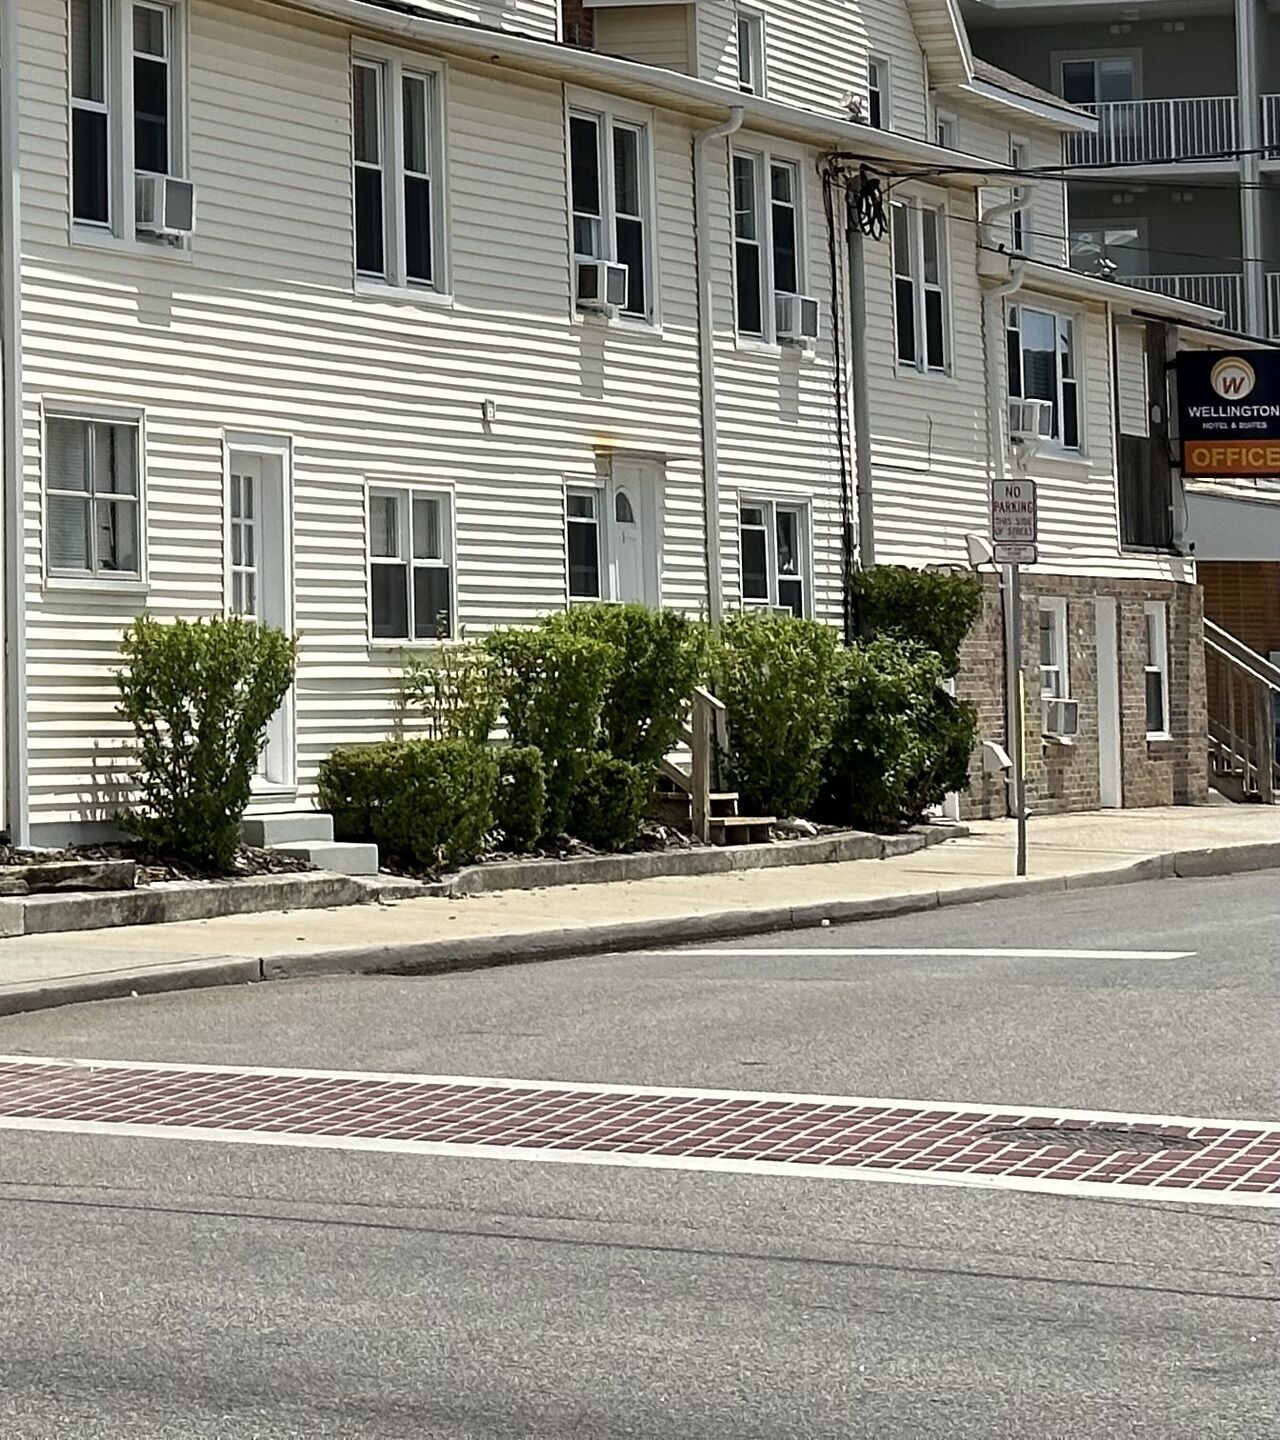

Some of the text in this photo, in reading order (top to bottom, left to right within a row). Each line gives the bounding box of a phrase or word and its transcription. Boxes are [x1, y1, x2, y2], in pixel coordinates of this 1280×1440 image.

[1222, 376, 1245, 395] W
[1188, 405, 1280, 418] WELLINGTON
[1192, 447, 1280, 467] OFFICE
[1005, 485, 1021, 499] NO
[993, 500, 1033, 514] PARKING
